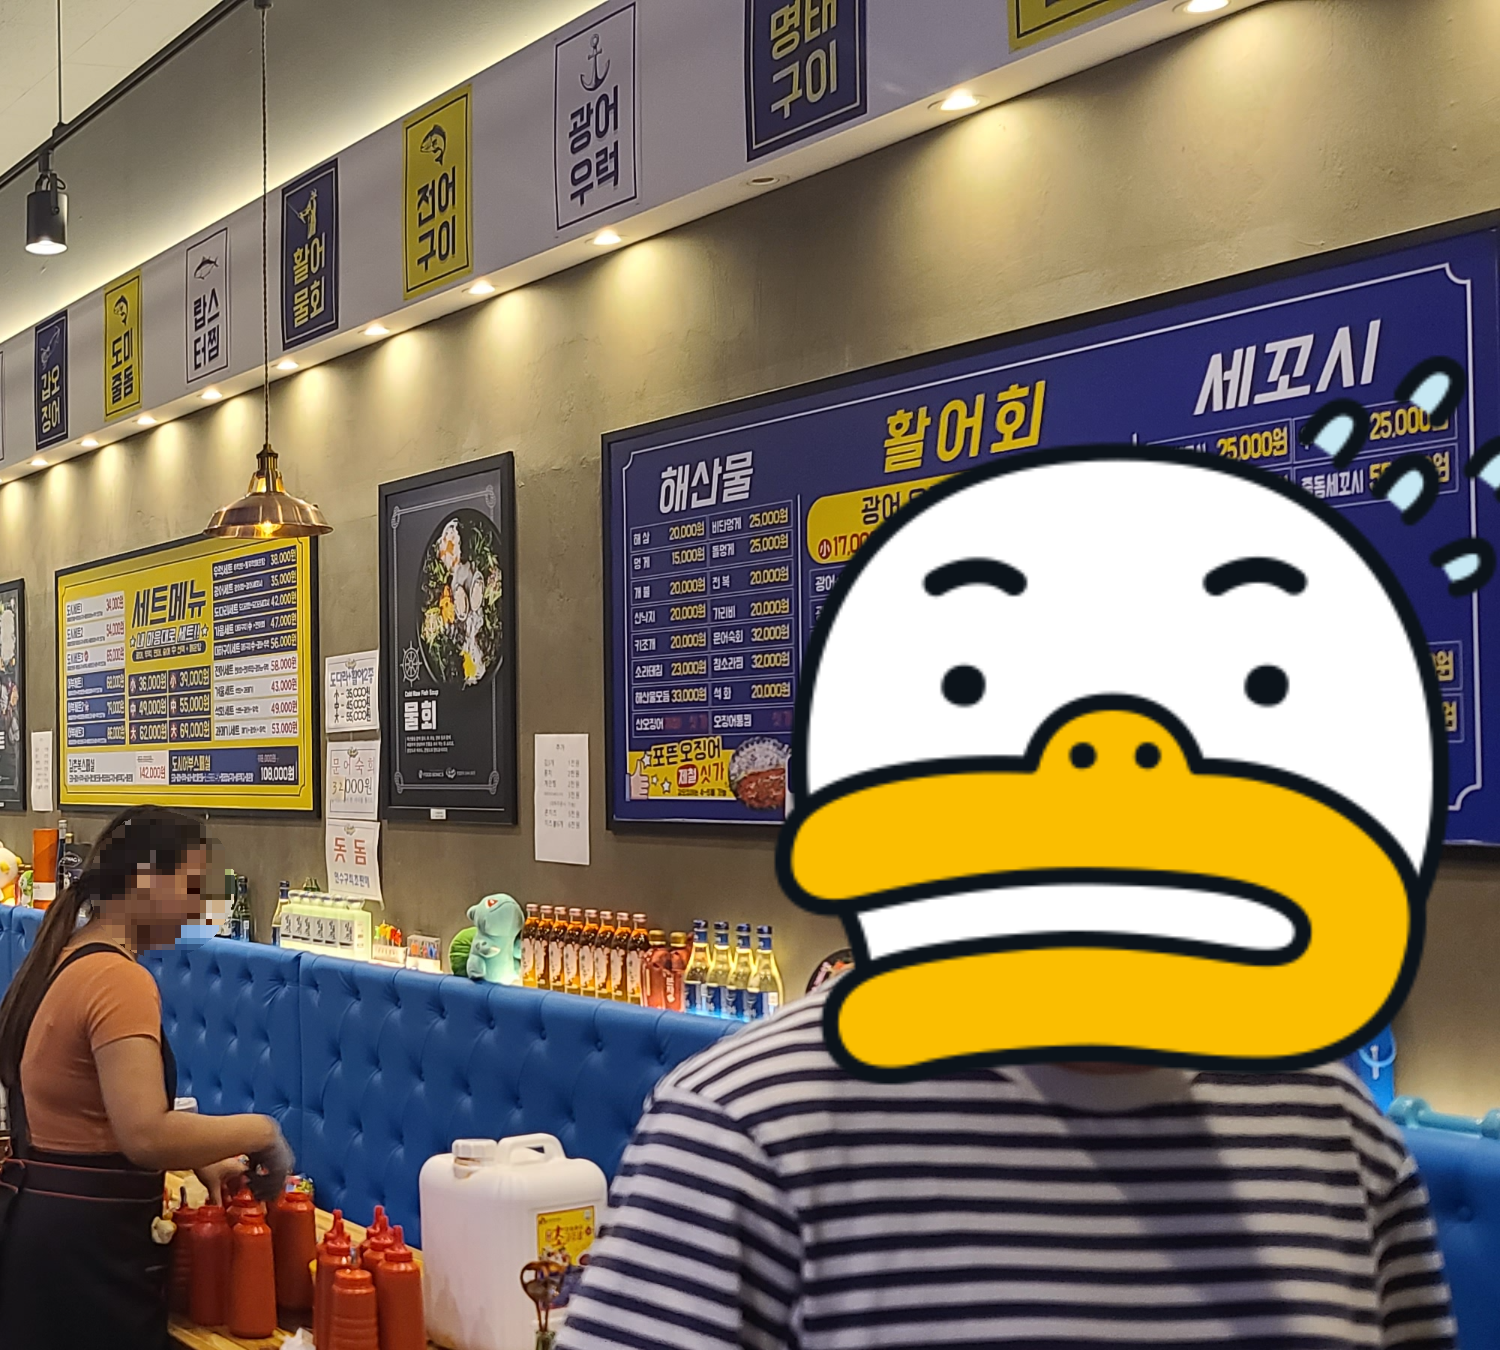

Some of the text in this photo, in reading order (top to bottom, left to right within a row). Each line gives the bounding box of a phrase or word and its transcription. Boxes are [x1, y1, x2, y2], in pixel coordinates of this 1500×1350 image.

[770, 0, 838, 61] 명태
[770, 38, 838, 120] 구이
[568, 84, 619, 155] 광어
[569, 139, 620, 207] 우럭
[416, 165, 457, 228] 전어
[293, 231, 326, 287] 활어
[416, 214, 457, 273] 구이
[193, 287, 220, 332] 랍스
[293, 275, 326, 329] 물회
[111, 327, 134, 370] 도미
[193, 324, 220, 371] 터찜
[1193, 318, 1382, 416] 세꼬시
[41, 364, 61, 403] 갑오
[111, 363, 134, 405] 줄돔
[41, 396, 61, 434] 징어
[883, 380, 1046, 474] 활어회
[1369, 406, 1449, 441] 25,000
[1216, 426, 1288, 462] 25,000원
[659, 450, 754, 514] 해산물
[749, 507, 789, 529] 25,000원
[861, 491, 901, 525] 광어
[668, 520, 705, 541] 20,000원
[749, 532, 789, 554] 25,000원
[671, 546, 706, 566] 15,000원
[669, 576, 706, 596] 20,000원
[749, 565, 789, 586] 20,000원
[131, 579, 207, 629] 세트메뉴
[669, 603, 706, 622] 20,000원
[712, 597, 790, 620] 가리비 20,000원
[146, 627, 177, 648] 마음대로
[670, 631, 706, 650] 20,000원
[750, 623, 790, 642] 32,000원
[670, 659, 707, 677] 23,000원
[751, 651, 790, 669] 32,000원
[179, 668, 210, 687] 39,000원
[751, 681, 791, 699] 20,000원
[179, 694, 210, 713] 55,000원
[671, 686, 707, 703] 33,000원
[179, 720, 210, 739] 69,000원
[404, 700, 437, 731] 물회
[139, 765, 166, 780] 142,000원
[677, 762, 725, 785] 제철 싯가
